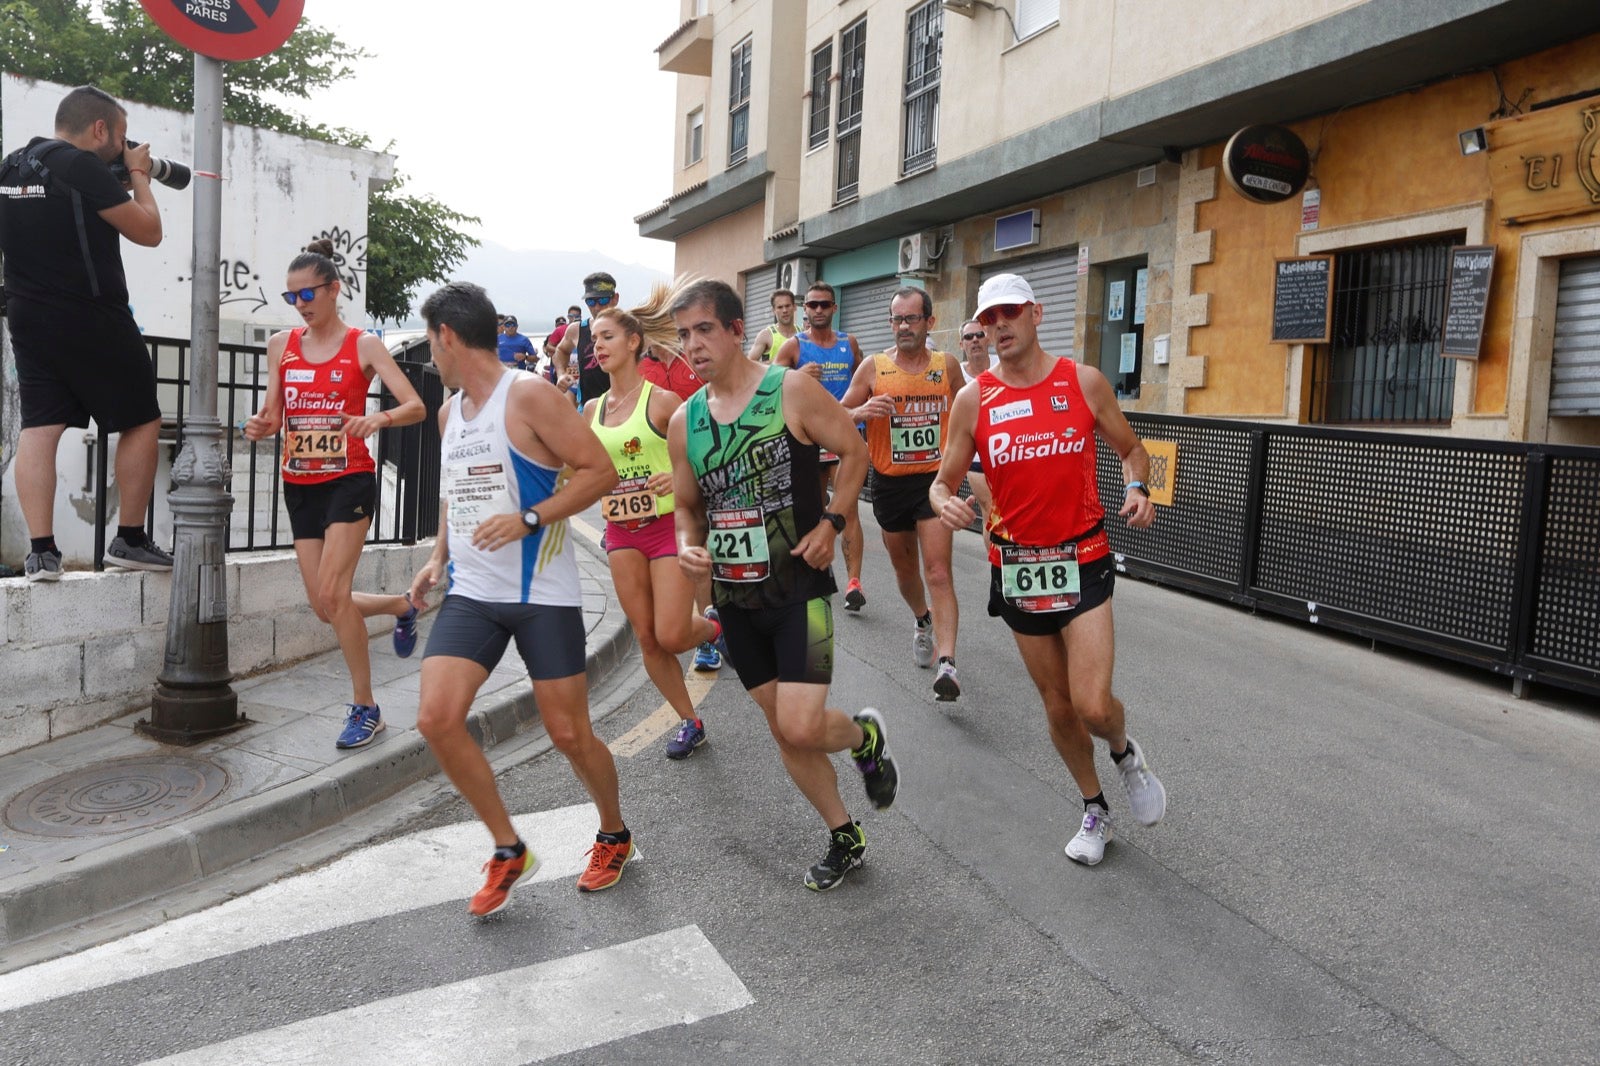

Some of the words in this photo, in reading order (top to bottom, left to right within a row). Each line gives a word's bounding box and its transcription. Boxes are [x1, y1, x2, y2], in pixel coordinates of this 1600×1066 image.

[186, 3, 227, 23] PARES
[191, 0, 231, 10] SES
[1526, 154, 1561, 190] El
[285, 387, 346, 410] Polisalud
[905, 394, 943, 403] Deportivo
[295, 434, 342, 453] 2140
[901, 428, 935, 448] 160
[1015, 431, 1055, 445] Clínicas
[988, 432, 1086, 469] Polisalud
[618, 464, 650, 474] TLETISMO
[477, 484, 506, 493] CONTRA
[608, 495, 652, 517] 2169
[714, 532, 753, 558] 221
[1017, 565, 1067, 591] 618
